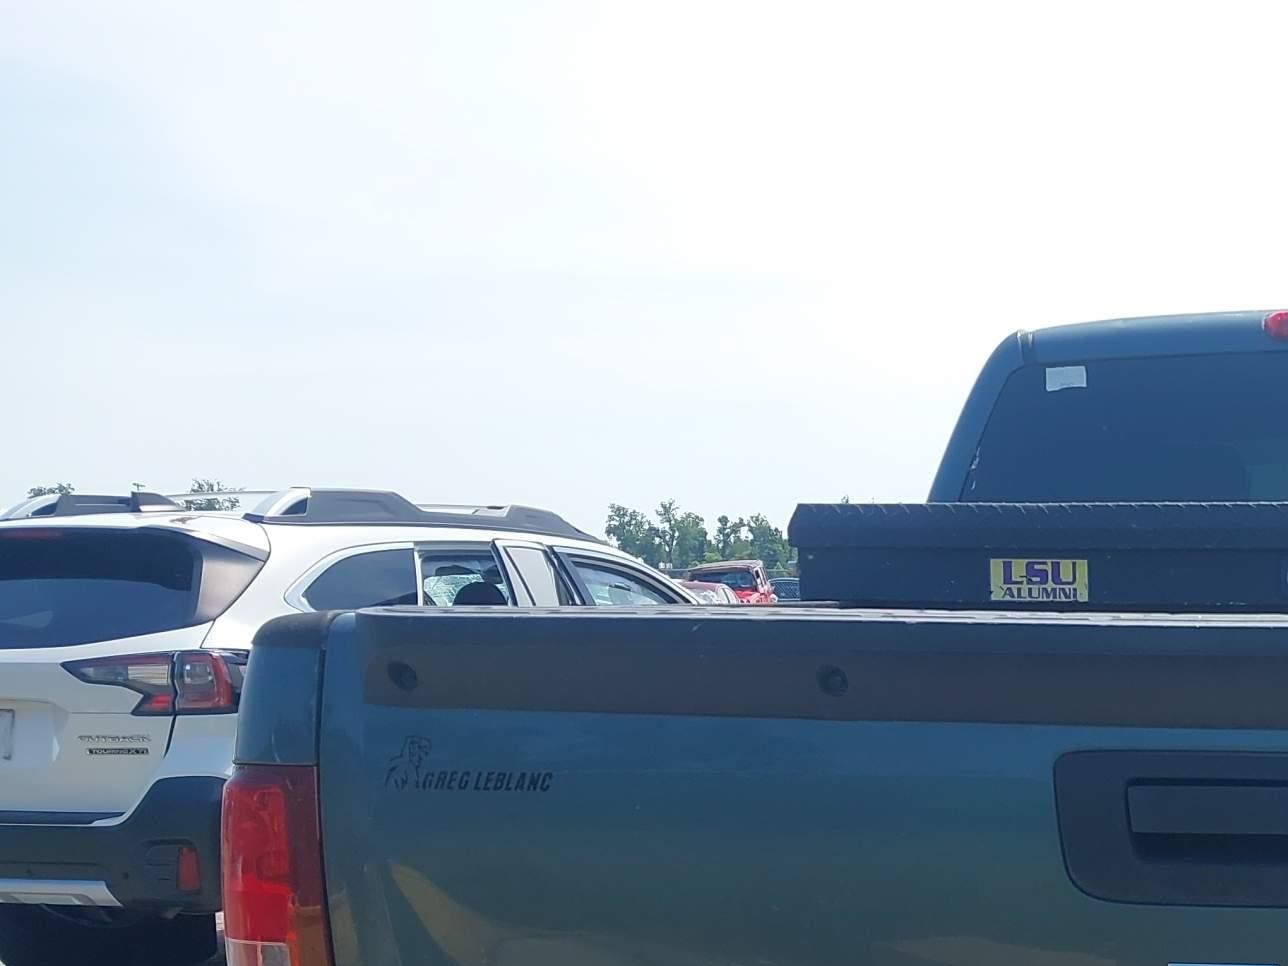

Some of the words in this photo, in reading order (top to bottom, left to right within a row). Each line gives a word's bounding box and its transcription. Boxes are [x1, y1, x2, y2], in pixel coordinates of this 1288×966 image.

[1002, 560, 1077, 585] LSU
[1002, 587, 1077, 599] ALUMNI
[421, 770, 470, 790] GREG
[474, 771, 553, 793] LEBLANC
